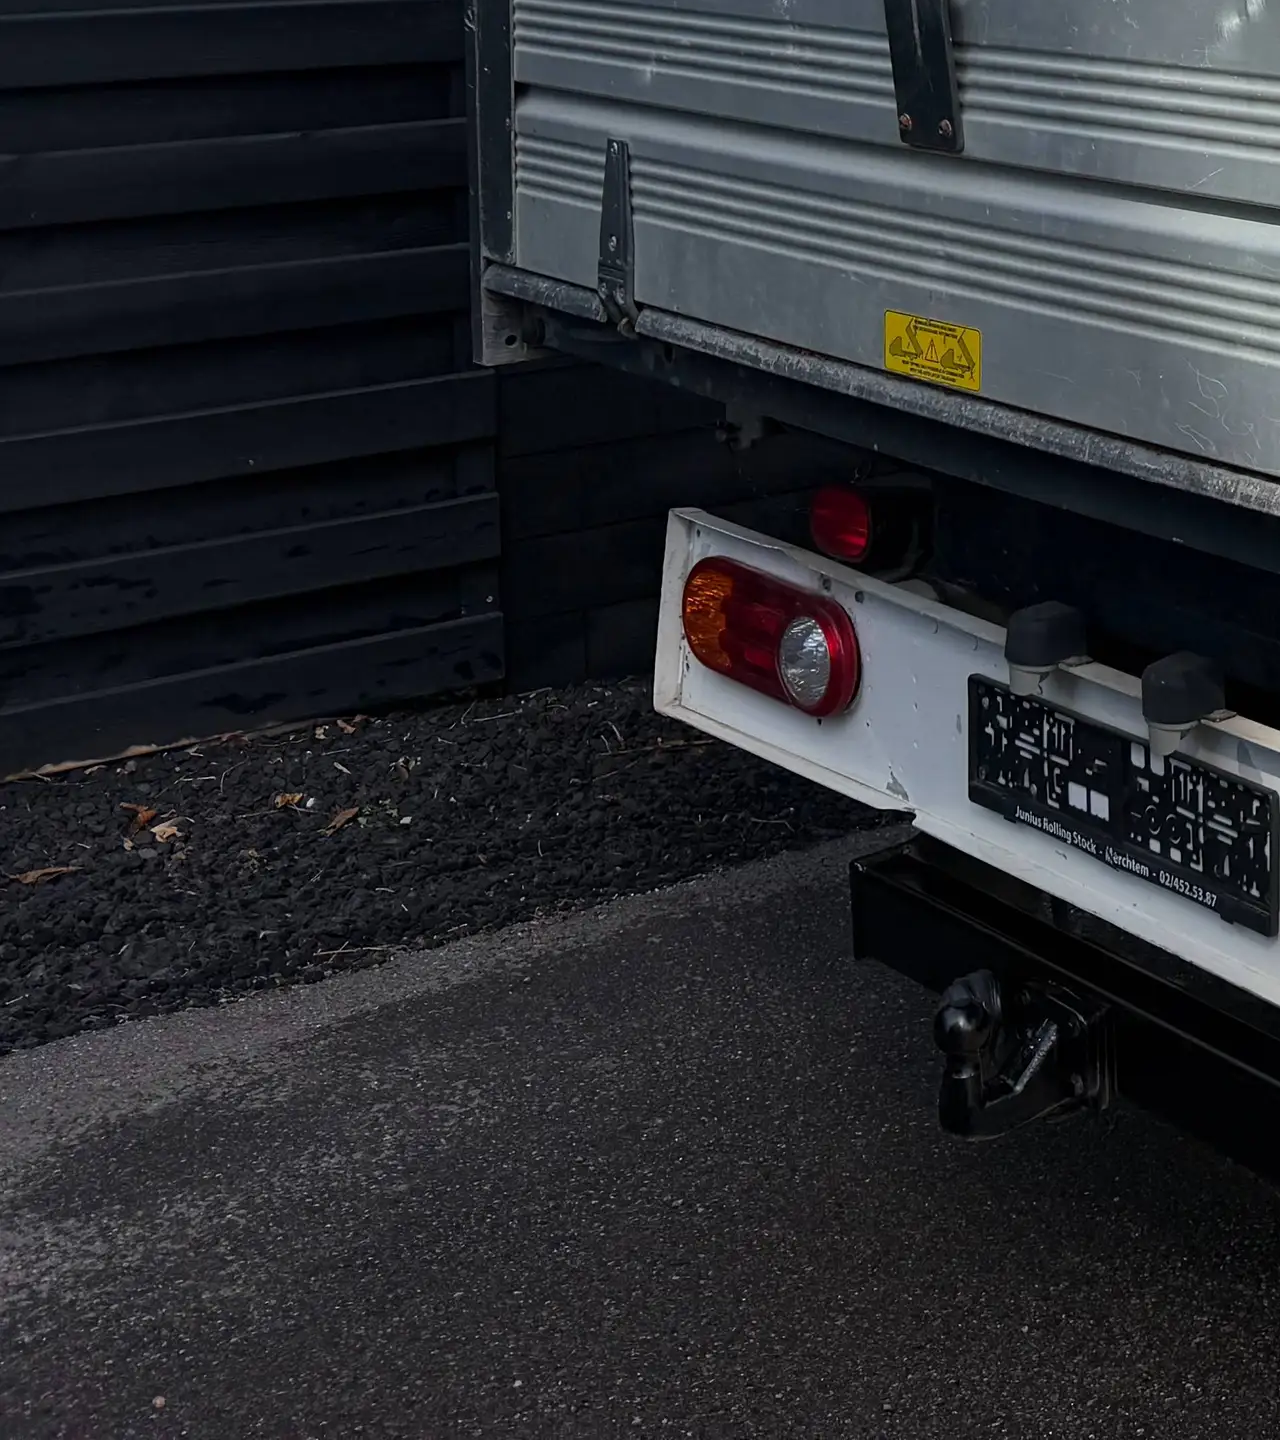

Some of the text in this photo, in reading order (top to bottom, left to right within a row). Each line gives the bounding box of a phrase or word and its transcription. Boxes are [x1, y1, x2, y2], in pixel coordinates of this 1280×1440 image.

[1015, 805, 1042, 828] Junius
[1043, 817, 1072, 845] Rolling
[1073, 831, 1097, 855] Stock
